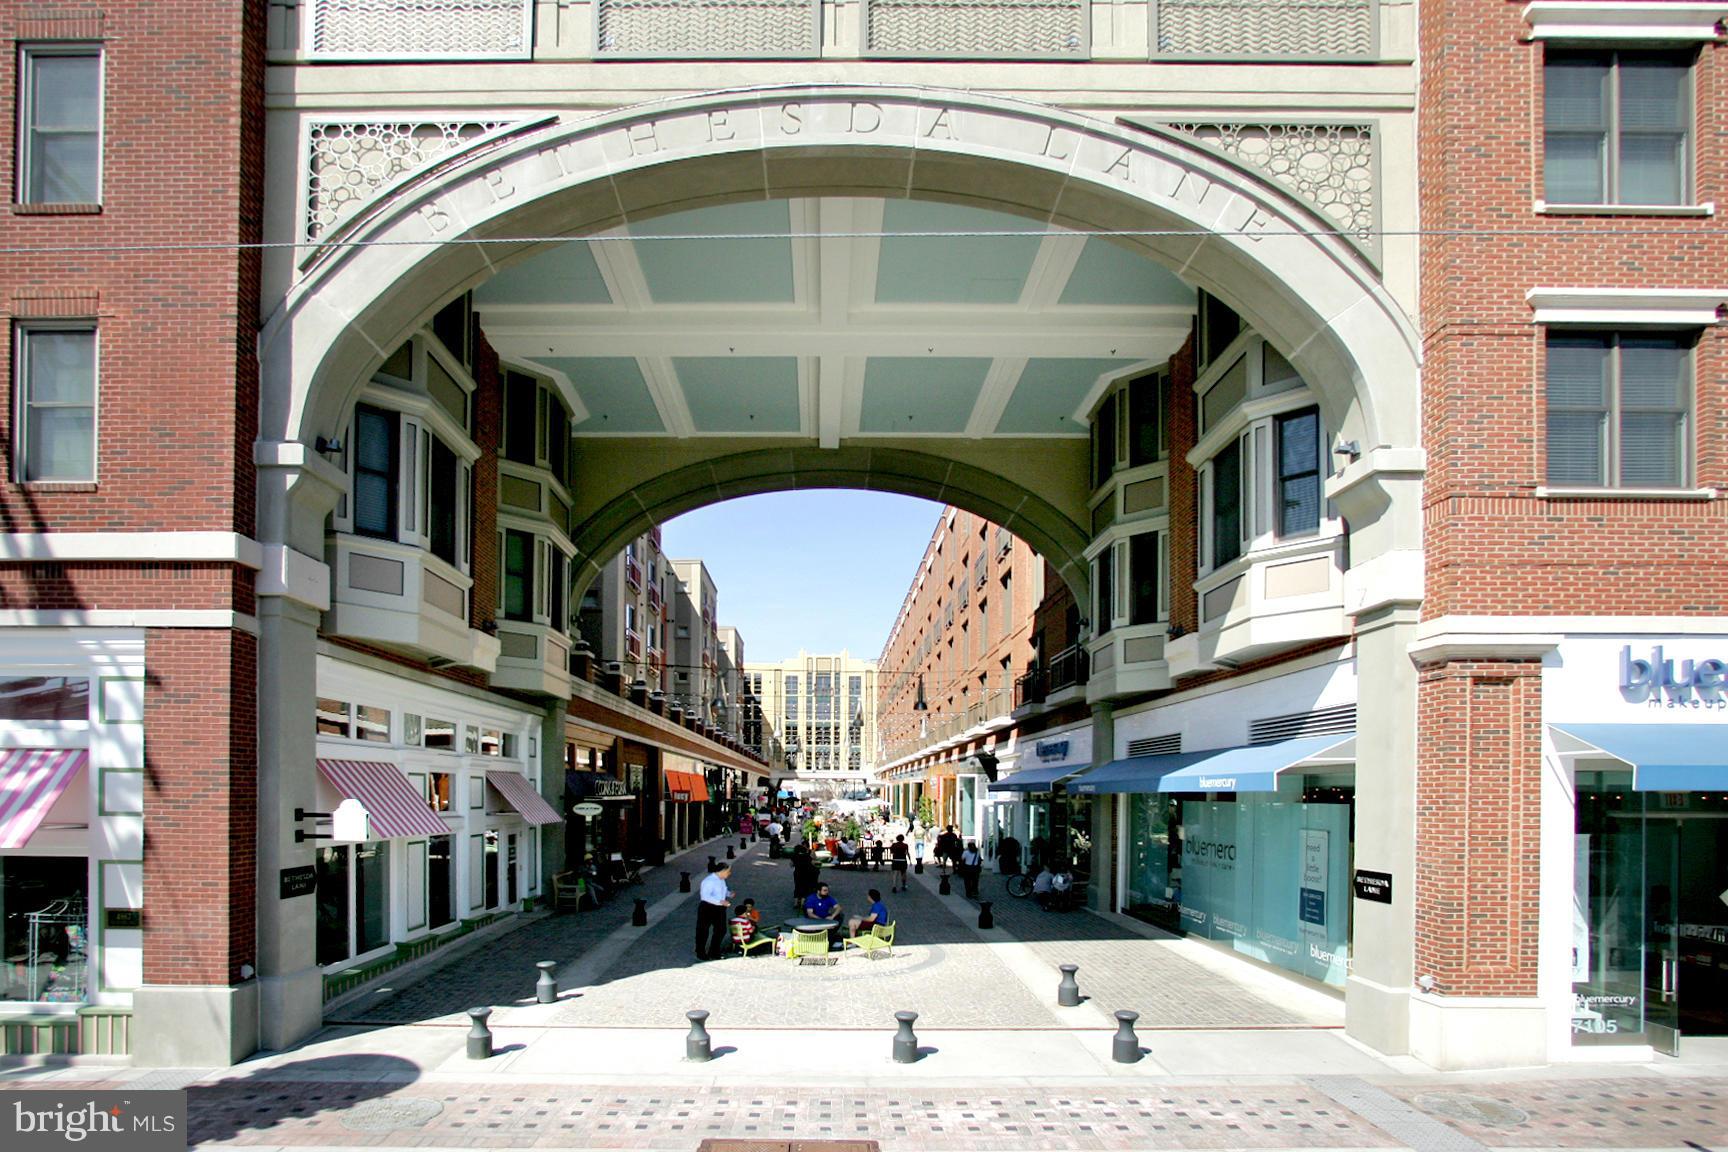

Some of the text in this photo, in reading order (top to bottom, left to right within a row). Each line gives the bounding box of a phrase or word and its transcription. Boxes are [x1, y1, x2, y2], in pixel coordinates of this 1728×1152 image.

[415, 101, 1277, 243] BETHESDA LANE
[1619, 645, 1728, 688] blue
[1648, 695, 1727, 712] makeup
[1573, 1020, 1617, 1033] 7105
